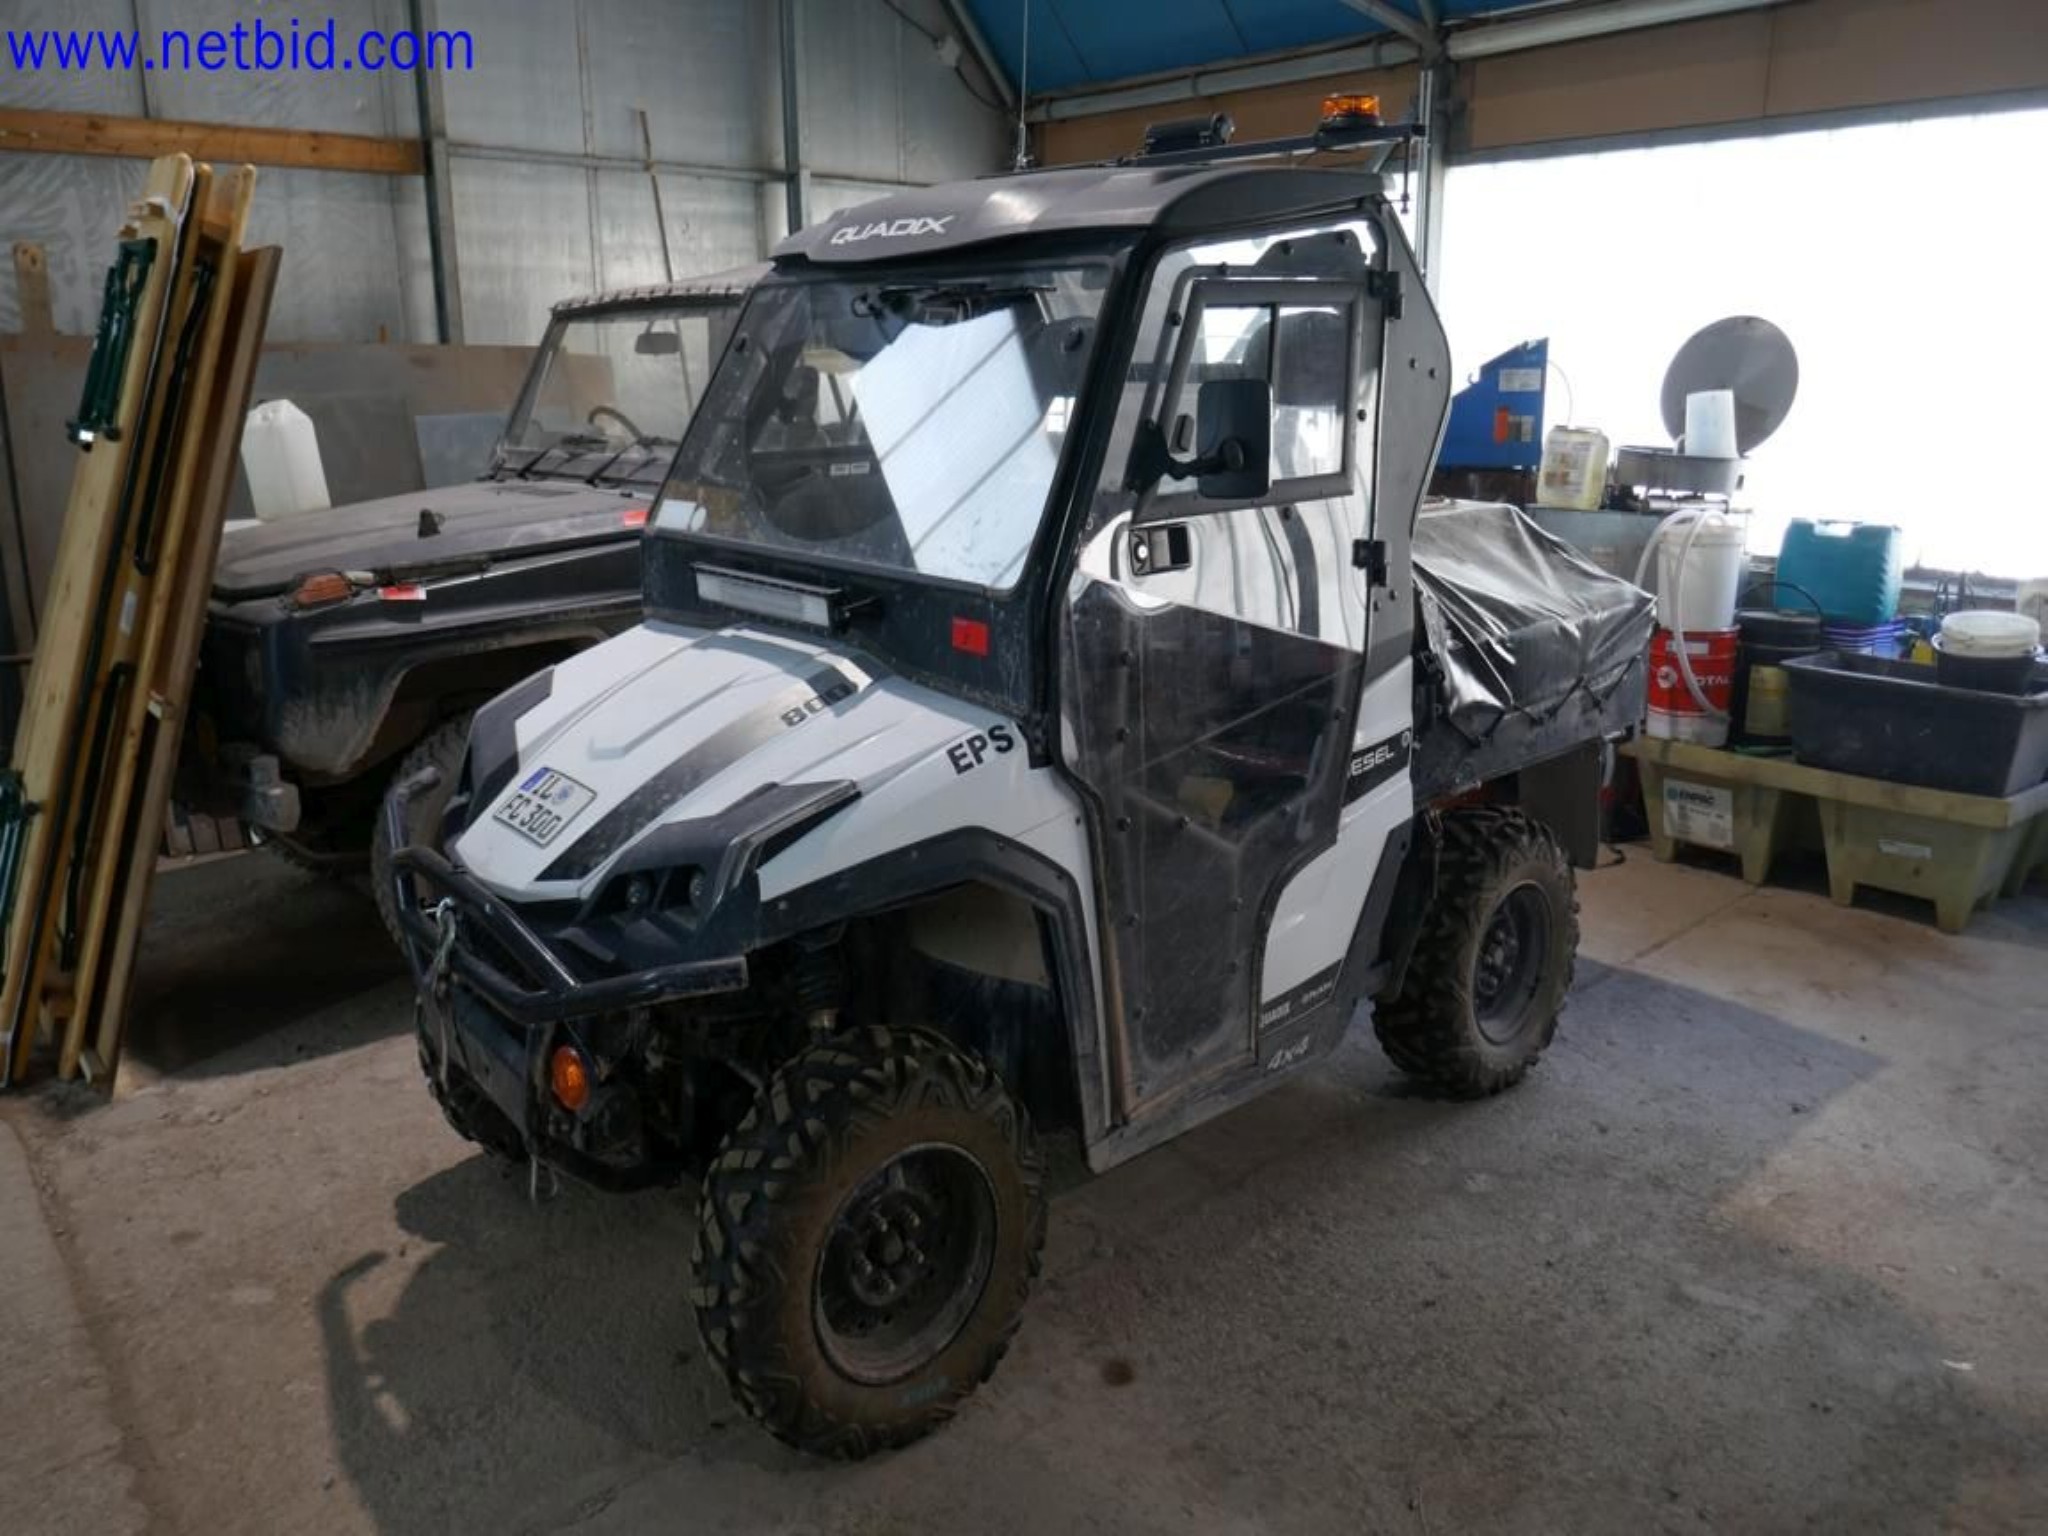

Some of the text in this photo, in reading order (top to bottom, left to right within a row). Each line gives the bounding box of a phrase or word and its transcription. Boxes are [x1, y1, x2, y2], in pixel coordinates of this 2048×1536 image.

[830, 214, 955, 245] QUADIX
[780, 681, 859, 728] 800
[945, 724, 1015, 776] EPS
[1347, 744, 1395, 777] ESEL
[532, 773, 563, 800] IL
[518, 802, 563, 840] 300
